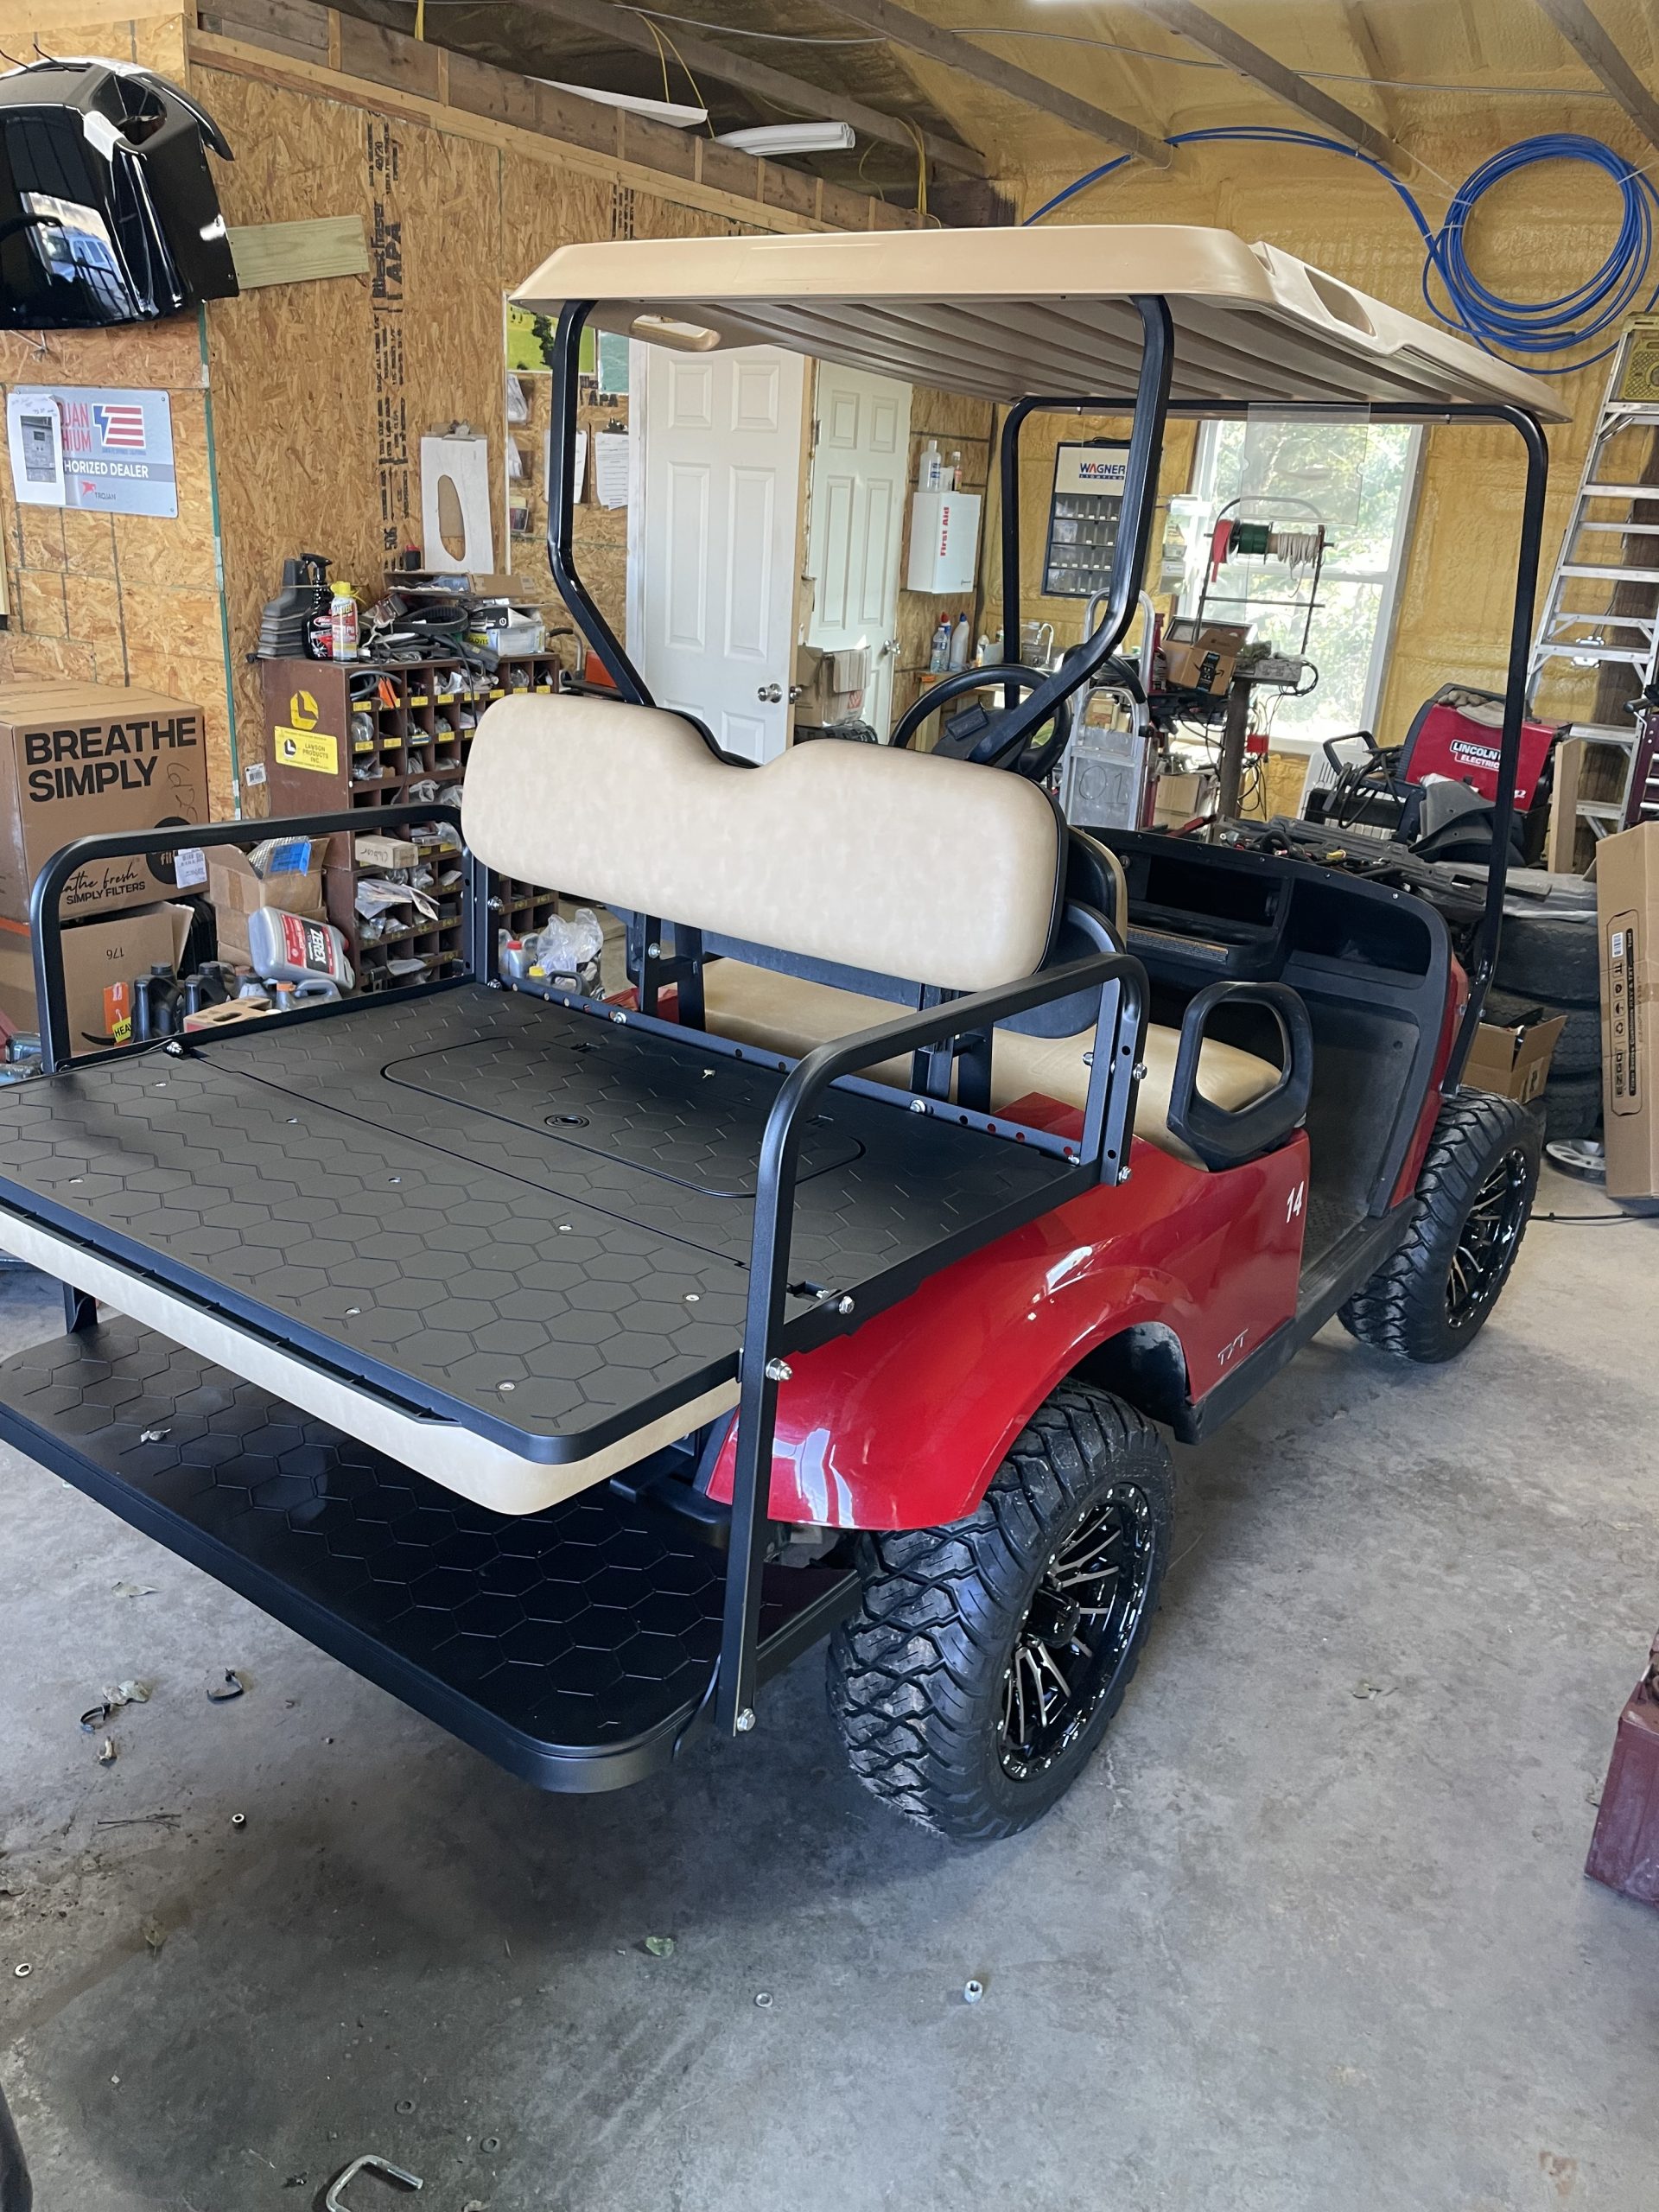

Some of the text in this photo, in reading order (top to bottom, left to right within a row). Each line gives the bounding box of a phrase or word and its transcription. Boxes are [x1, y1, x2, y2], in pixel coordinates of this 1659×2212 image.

[385, 221, 403, 284] APA
[57, 402, 90, 428] OJAN
[61, 428, 92, 453] HIUM
[64, 461, 149, 479] HORIZED DEALER
[1080, 462, 1126, 474] WAGNER
[94, 492, 117, 500] TROJAN
[24, 716, 197, 766] BREATHE
[304, 743, 326, 752] LAWSON
[1452, 742, 1498, 760] LINCOLN
[302, 749, 329, 760] PRODUCTS
[1460, 754, 1500, 769] ELECTRIC
[28, 755, 158, 802] SIMPLY
[67, 881, 146, 905] SIMPLY FILTERS
[106, 947, 124, 960] 176
[309, 928, 327, 964] ZEREX
[1287, 1180, 1304, 1224] 14
[1217, 1328, 1249, 1365] TXT
